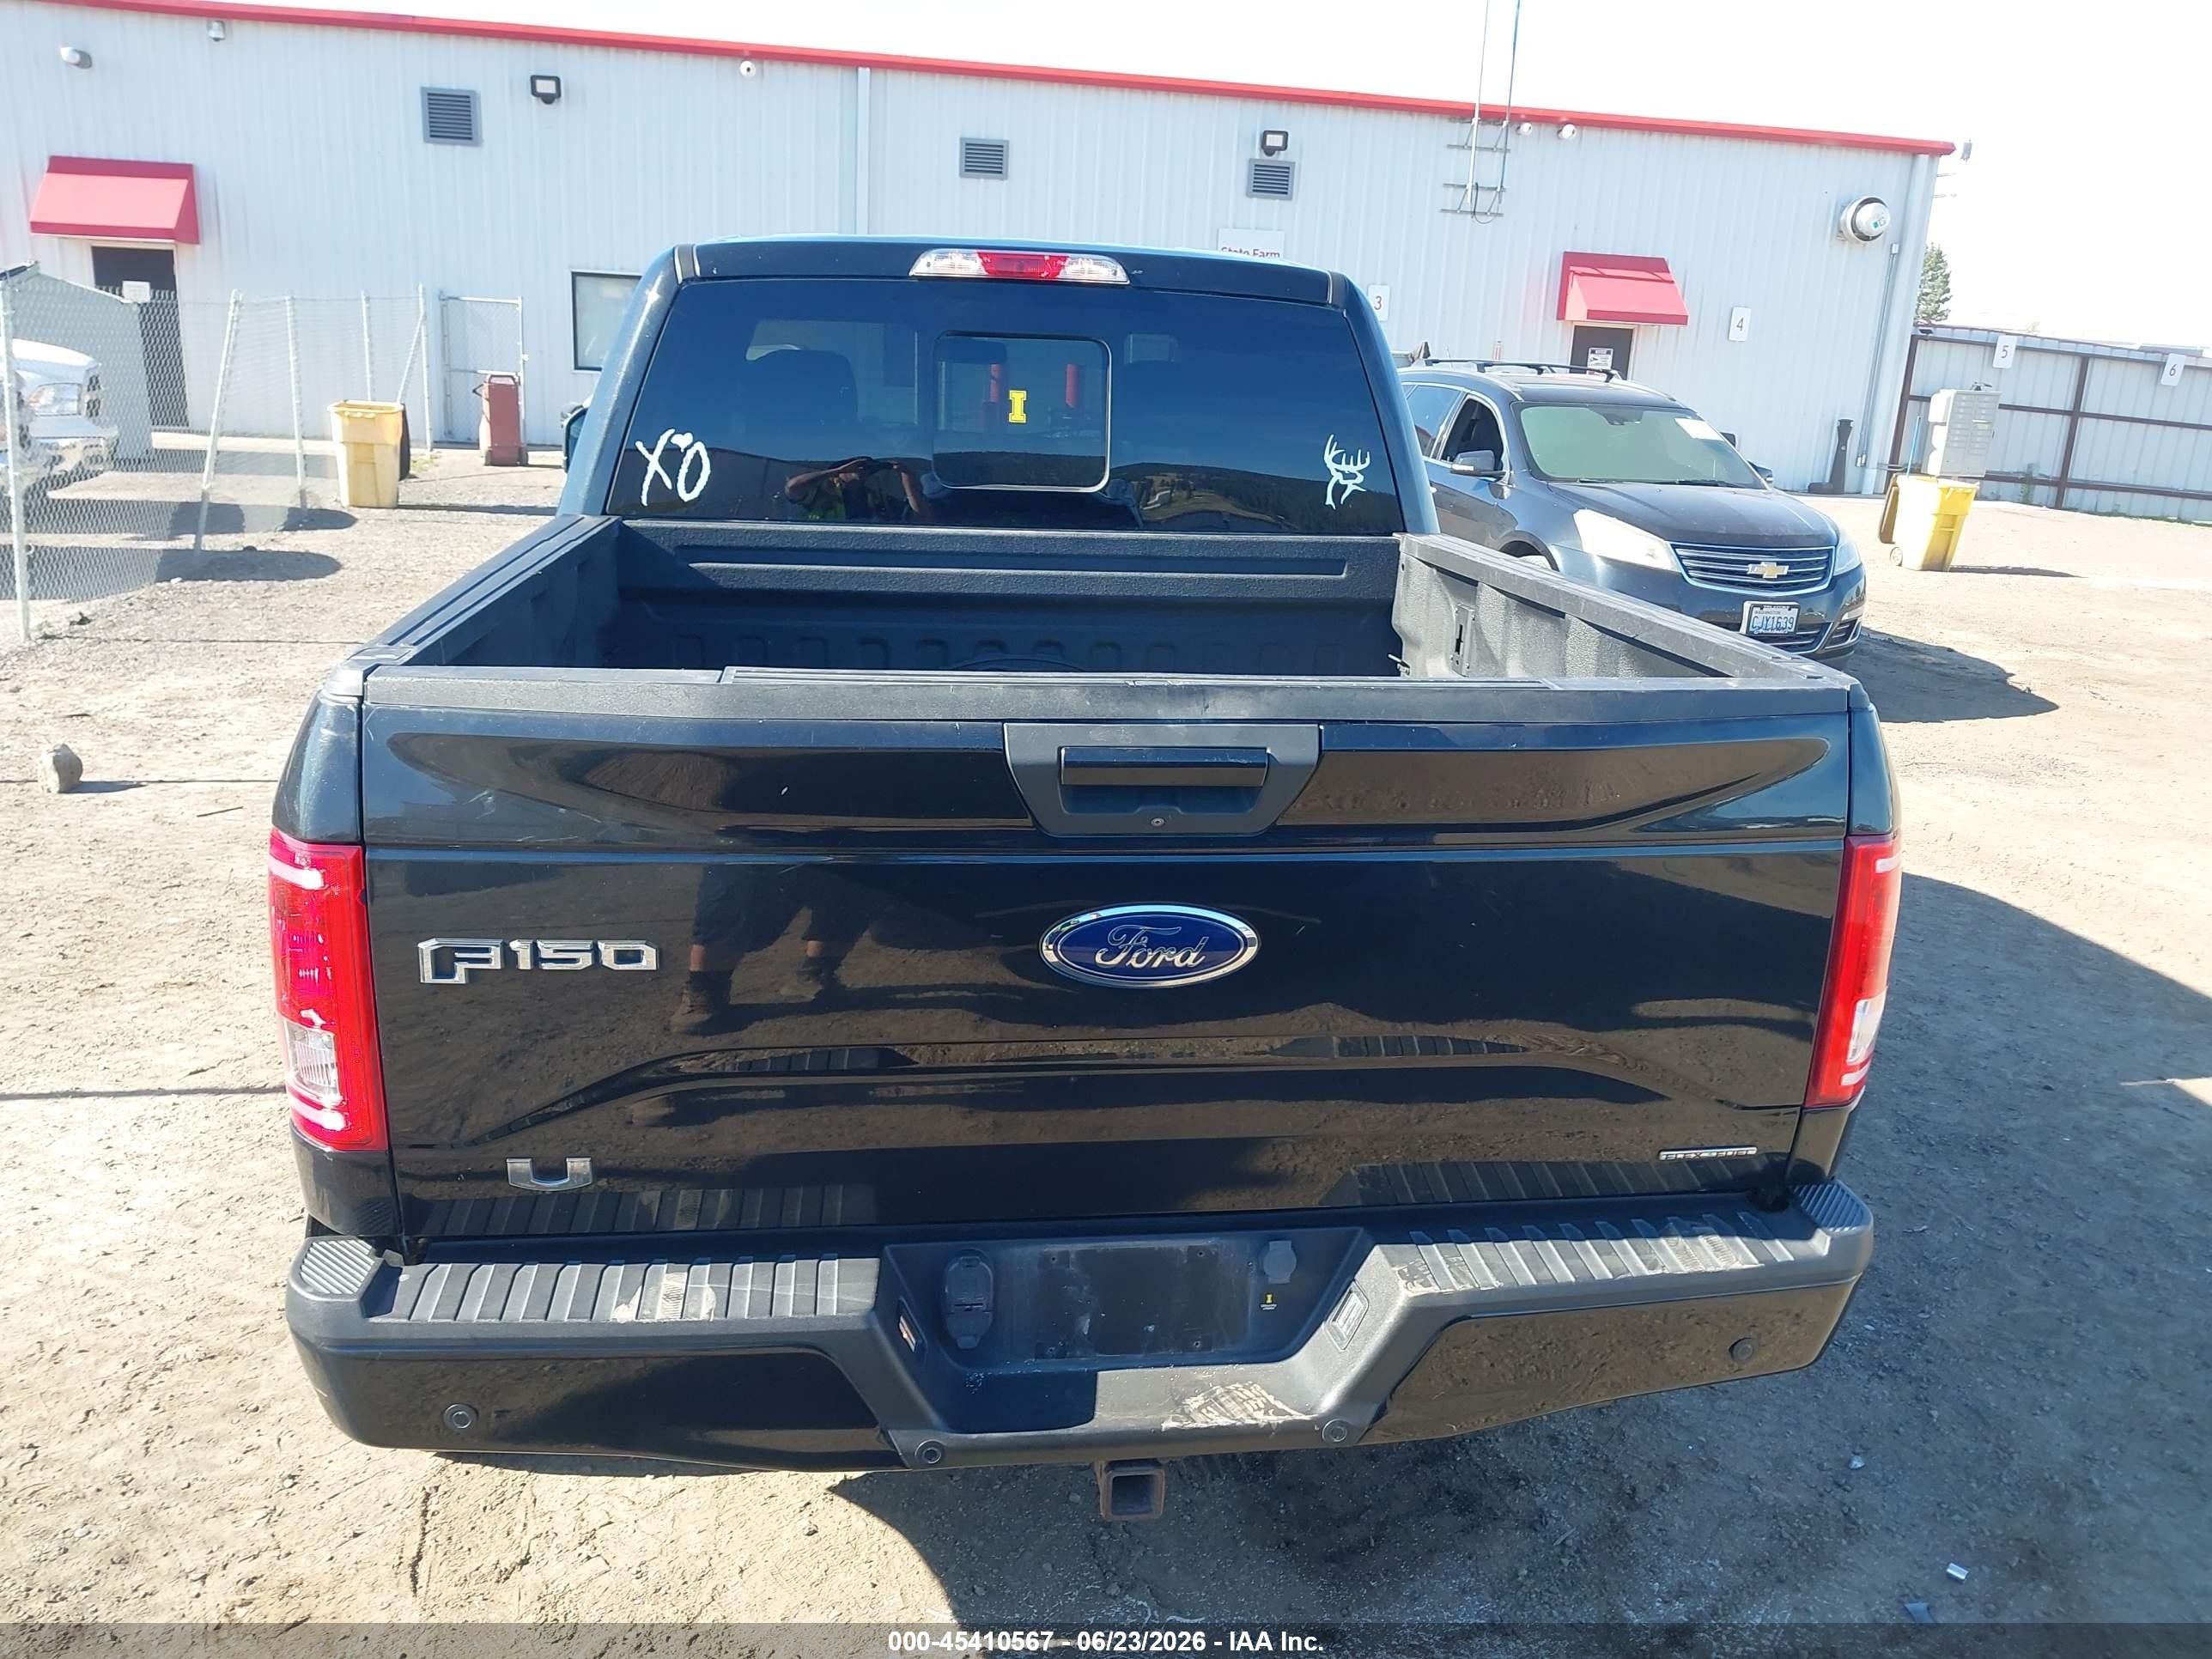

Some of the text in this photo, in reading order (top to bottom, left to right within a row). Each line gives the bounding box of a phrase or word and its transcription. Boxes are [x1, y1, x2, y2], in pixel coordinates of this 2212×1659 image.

[1374, 296, 1382, 310] 3
[1736, 317, 1744, 331] 4
[2001, 345, 2009, 358] 5
[2169, 363, 2177, 376] 6
[635, 428, 711, 505] XO
[1095, 924, 1209, 969] Ford
